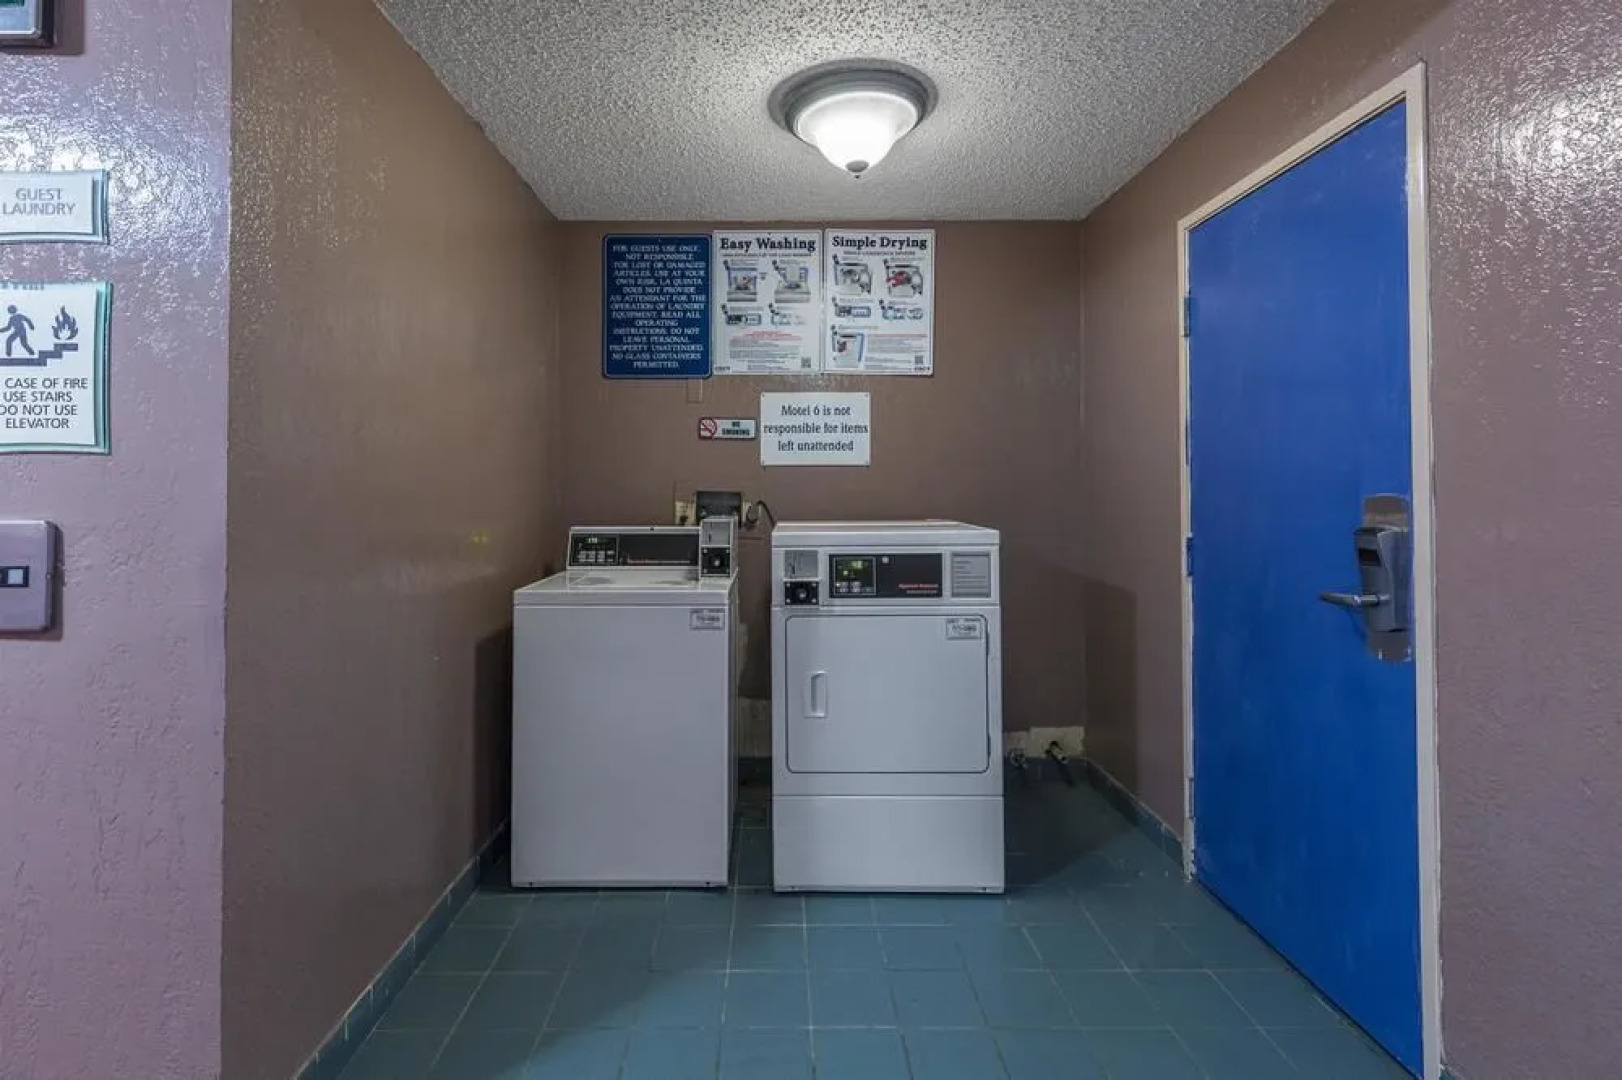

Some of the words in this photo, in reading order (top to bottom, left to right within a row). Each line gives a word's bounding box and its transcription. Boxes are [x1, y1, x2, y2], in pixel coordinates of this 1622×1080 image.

[15, 188, 64, 200] GUEST
[2, 202, 76, 215] LAUNDRY
[721, 238, 752, 252] Easy
[756, 238, 816, 252] Washing
[832, 236, 877, 250] Simple
[880, 236, 927, 250] Drying
[4, 377, 38, 389] CASE
[41, 377, 60, 389] OF
[62, 377, 88, 389] FIRE
[3, 391, 26, 402] USE
[31, 391, 73, 402] STAIRS
[22, 404, 51, 415] NOT
[54, 404, 78, 415] USE
[781, 405, 810, 415] Motel
[813, 405, 820, 415] 6
[823, 405, 831, 415] is
[834, 406, 850, 415] not
[5, 418, 70, 429] ELEVATOR
[763, 422, 821, 436] responsible
[824, 422, 838, 433] for
[841, 422, 868, 433] items
[778, 440, 794, 451] left
[797, 440, 854, 451] unattended
